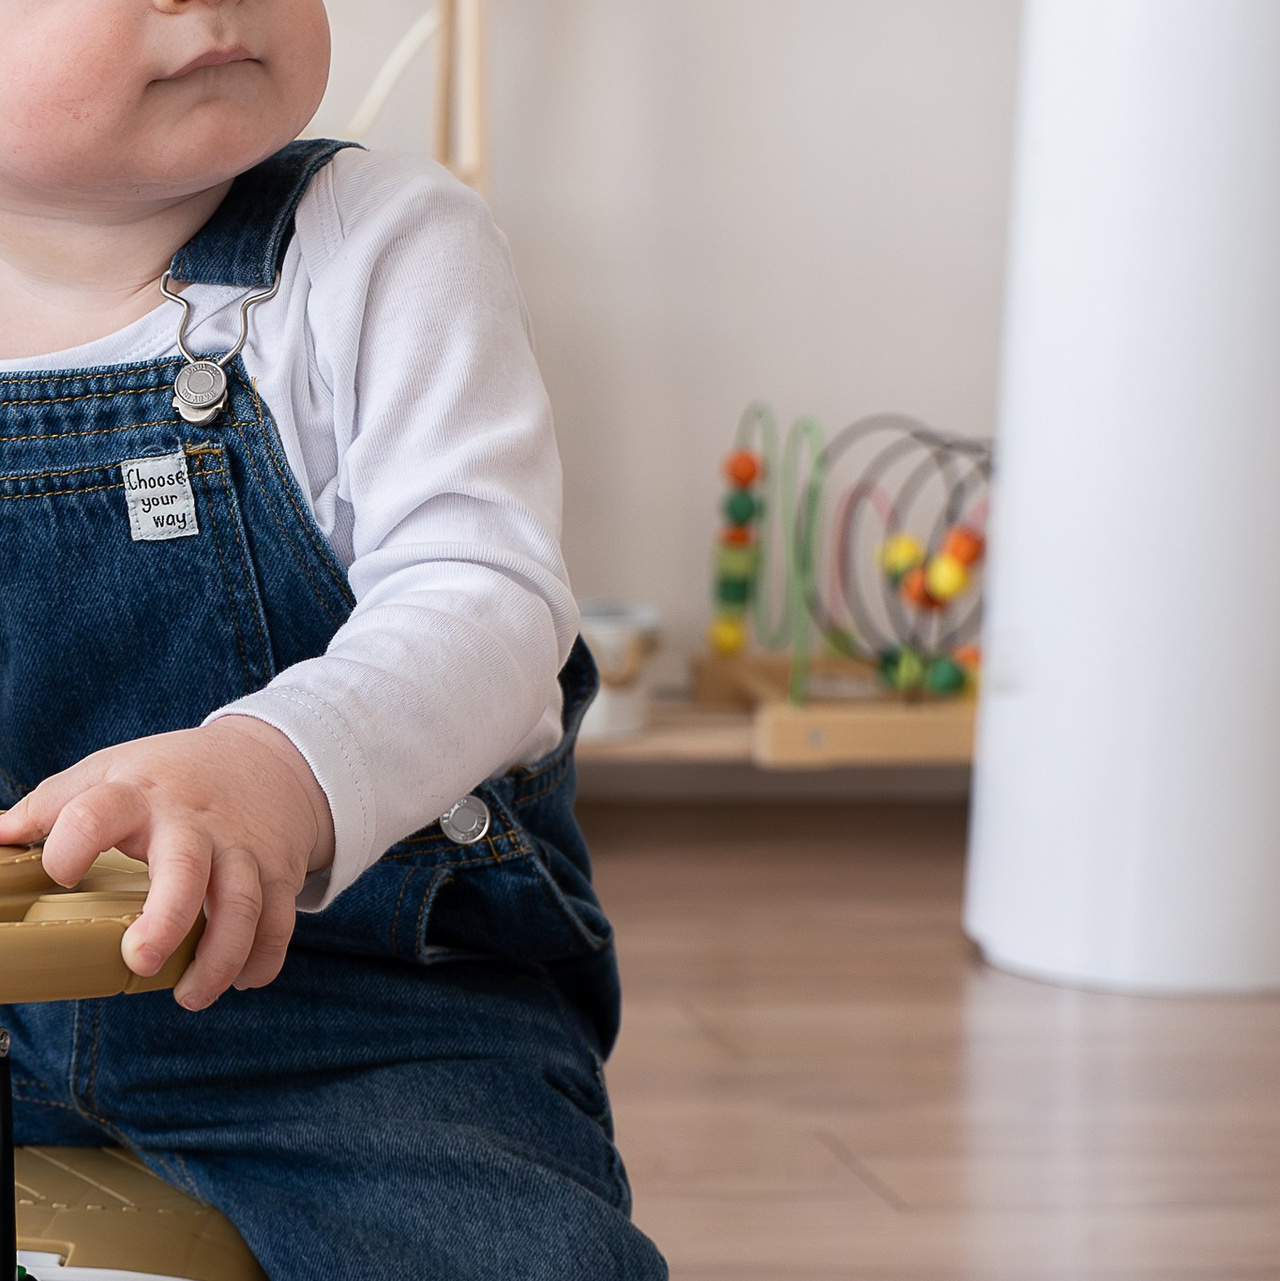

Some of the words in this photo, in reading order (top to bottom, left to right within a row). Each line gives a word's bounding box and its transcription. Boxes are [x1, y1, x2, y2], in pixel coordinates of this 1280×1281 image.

[127, 468, 187, 491] Choose
[141, 494, 178, 513] your
[152, 512, 187, 530] way
